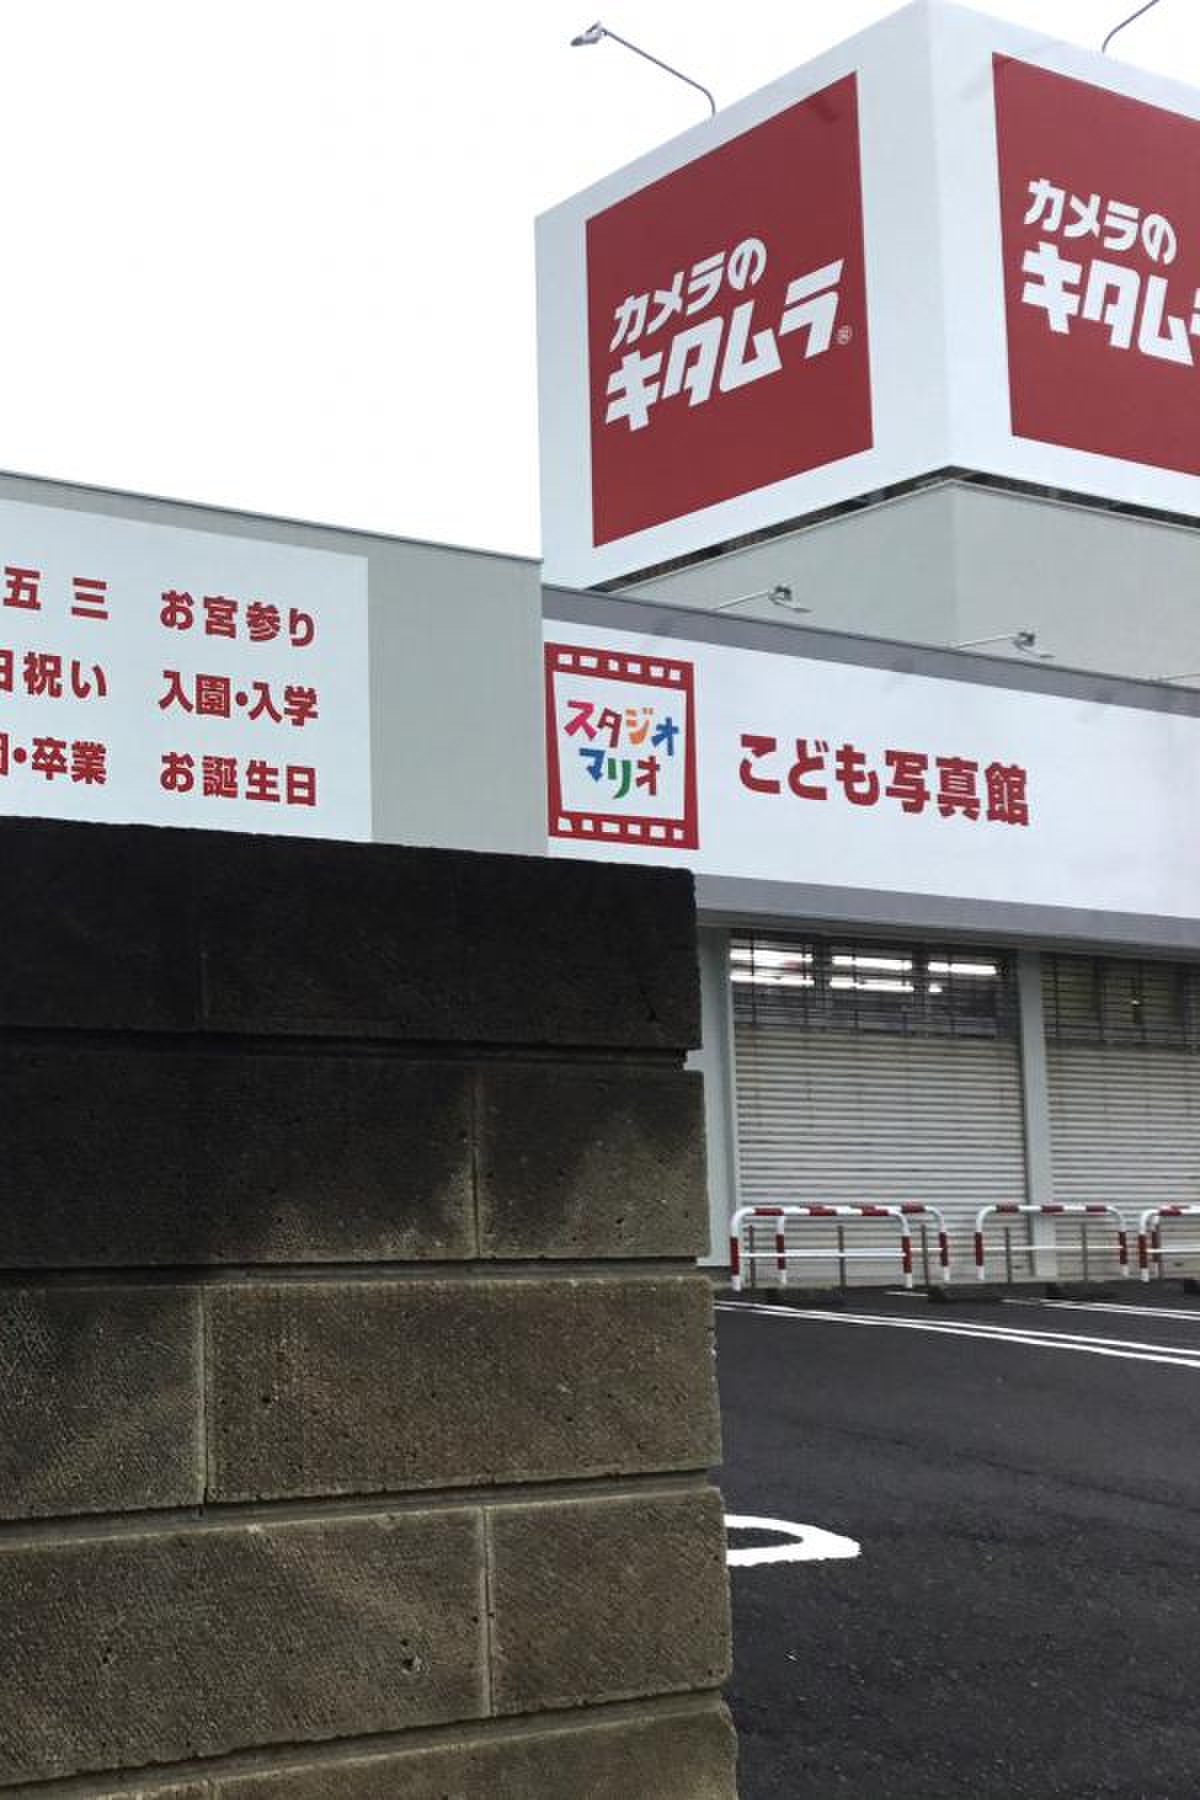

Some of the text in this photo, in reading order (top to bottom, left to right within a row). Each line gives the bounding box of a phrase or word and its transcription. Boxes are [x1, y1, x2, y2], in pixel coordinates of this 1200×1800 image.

[1024, 178, 1177, 265] カメラの
[609, 237, 767, 352] カメラの
[1022, 241, 1200, 366] キタム
[605, 259, 845, 432] キタムラ
[160, 590, 315, 647] お宮参り
[159, 670, 318, 726] 入園・入学
[564, 699, 680, 756] スタジオ
[160, 752, 317, 807] お誕生日
[578, 748, 661, 800] マリオ
[739, 734, 1030, 827] こども写真館
